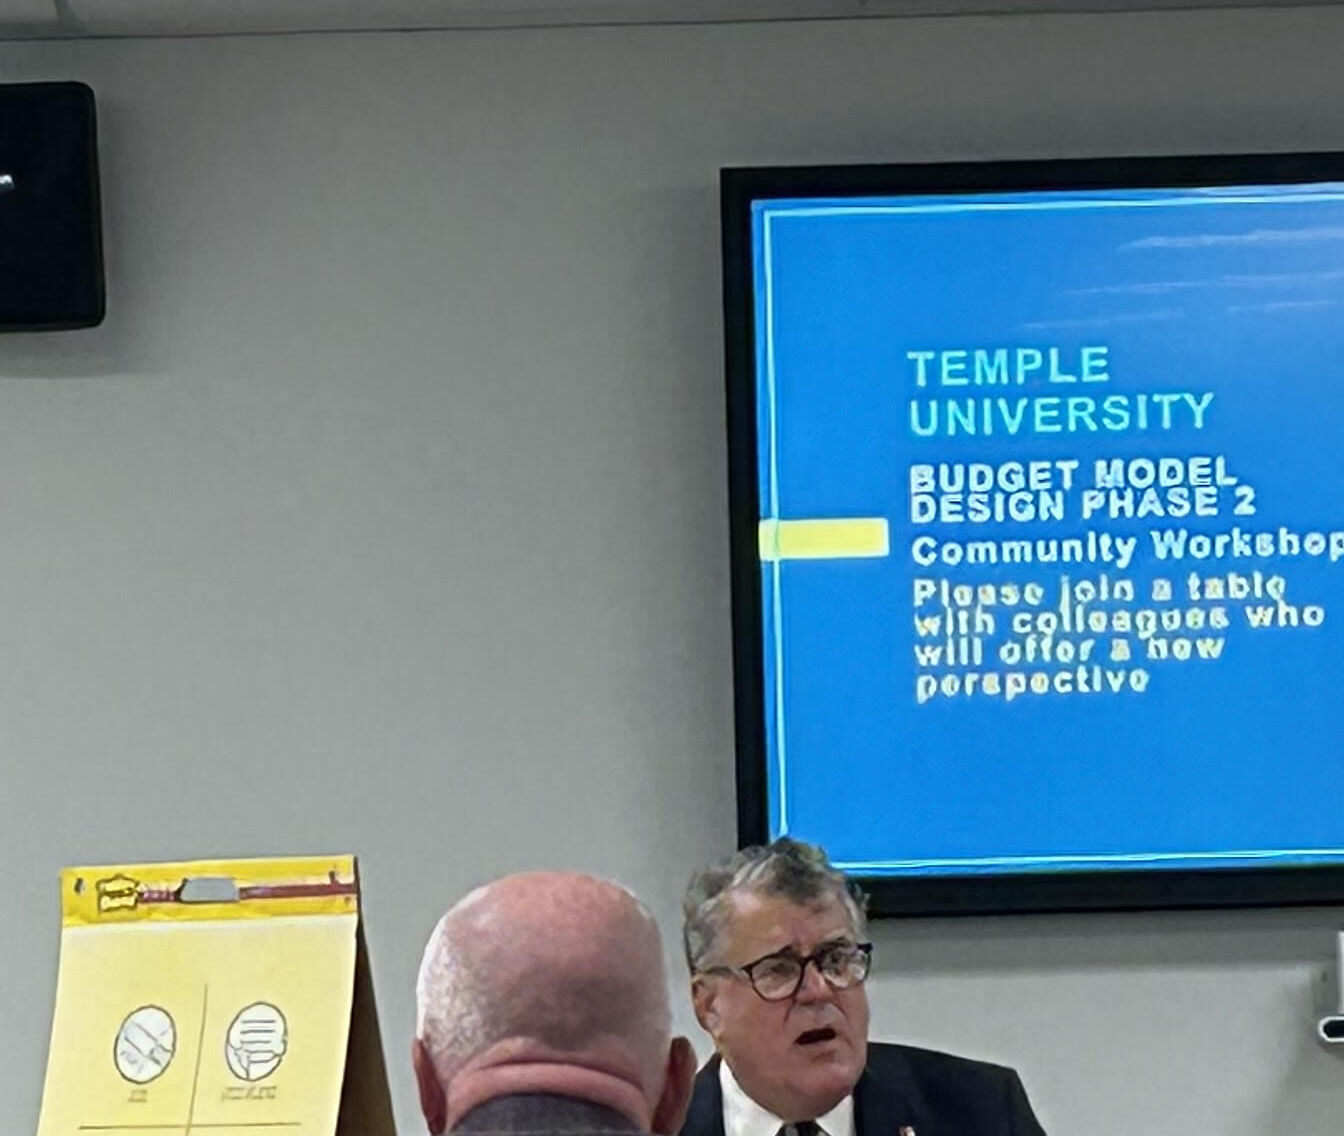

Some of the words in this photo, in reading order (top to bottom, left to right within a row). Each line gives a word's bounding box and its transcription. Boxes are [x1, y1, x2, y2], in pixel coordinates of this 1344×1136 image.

[907, 346, 1109, 387] TEMPLE
[910, 392, 1214, 436] UNIVERSITY
[909, 460, 1079, 494] BUDGET
[1094, 456, 1238, 489] MODEL
[910, 490, 1065, 523] DESIGN
[1082, 486, 1219, 519] PHASE
[1233, 485, 1256, 516] 2
[911, 530, 1137, 568] Community
[913, 576, 1044, 606] Please
[1188, 571, 1286, 600] table
[914, 605, 995, 637] with
[1013, 603, 1229, 639] colleagues
[1246, 598, 1325, 628] who
[915, 637, 981, 666] will
